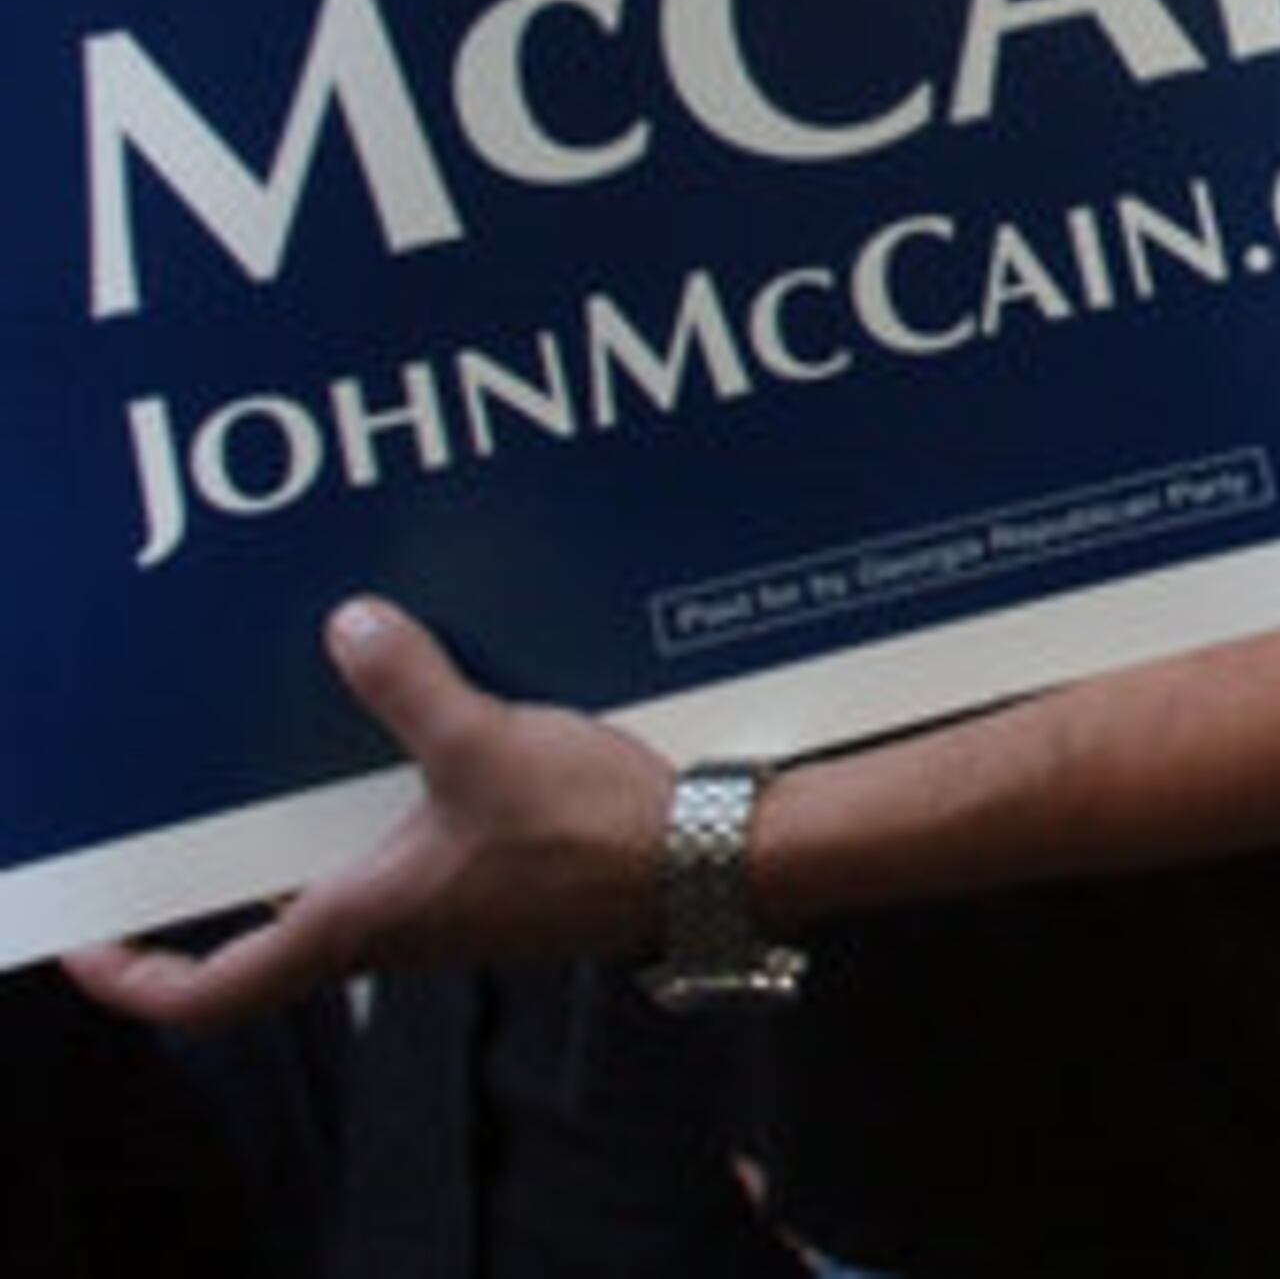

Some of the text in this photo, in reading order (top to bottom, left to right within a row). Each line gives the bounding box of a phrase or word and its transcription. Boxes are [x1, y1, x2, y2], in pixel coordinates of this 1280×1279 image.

[675, 592, 755, 632] Paid
[759, 580, 802, 608] for
[1166, 470, 1250, 509] Party
